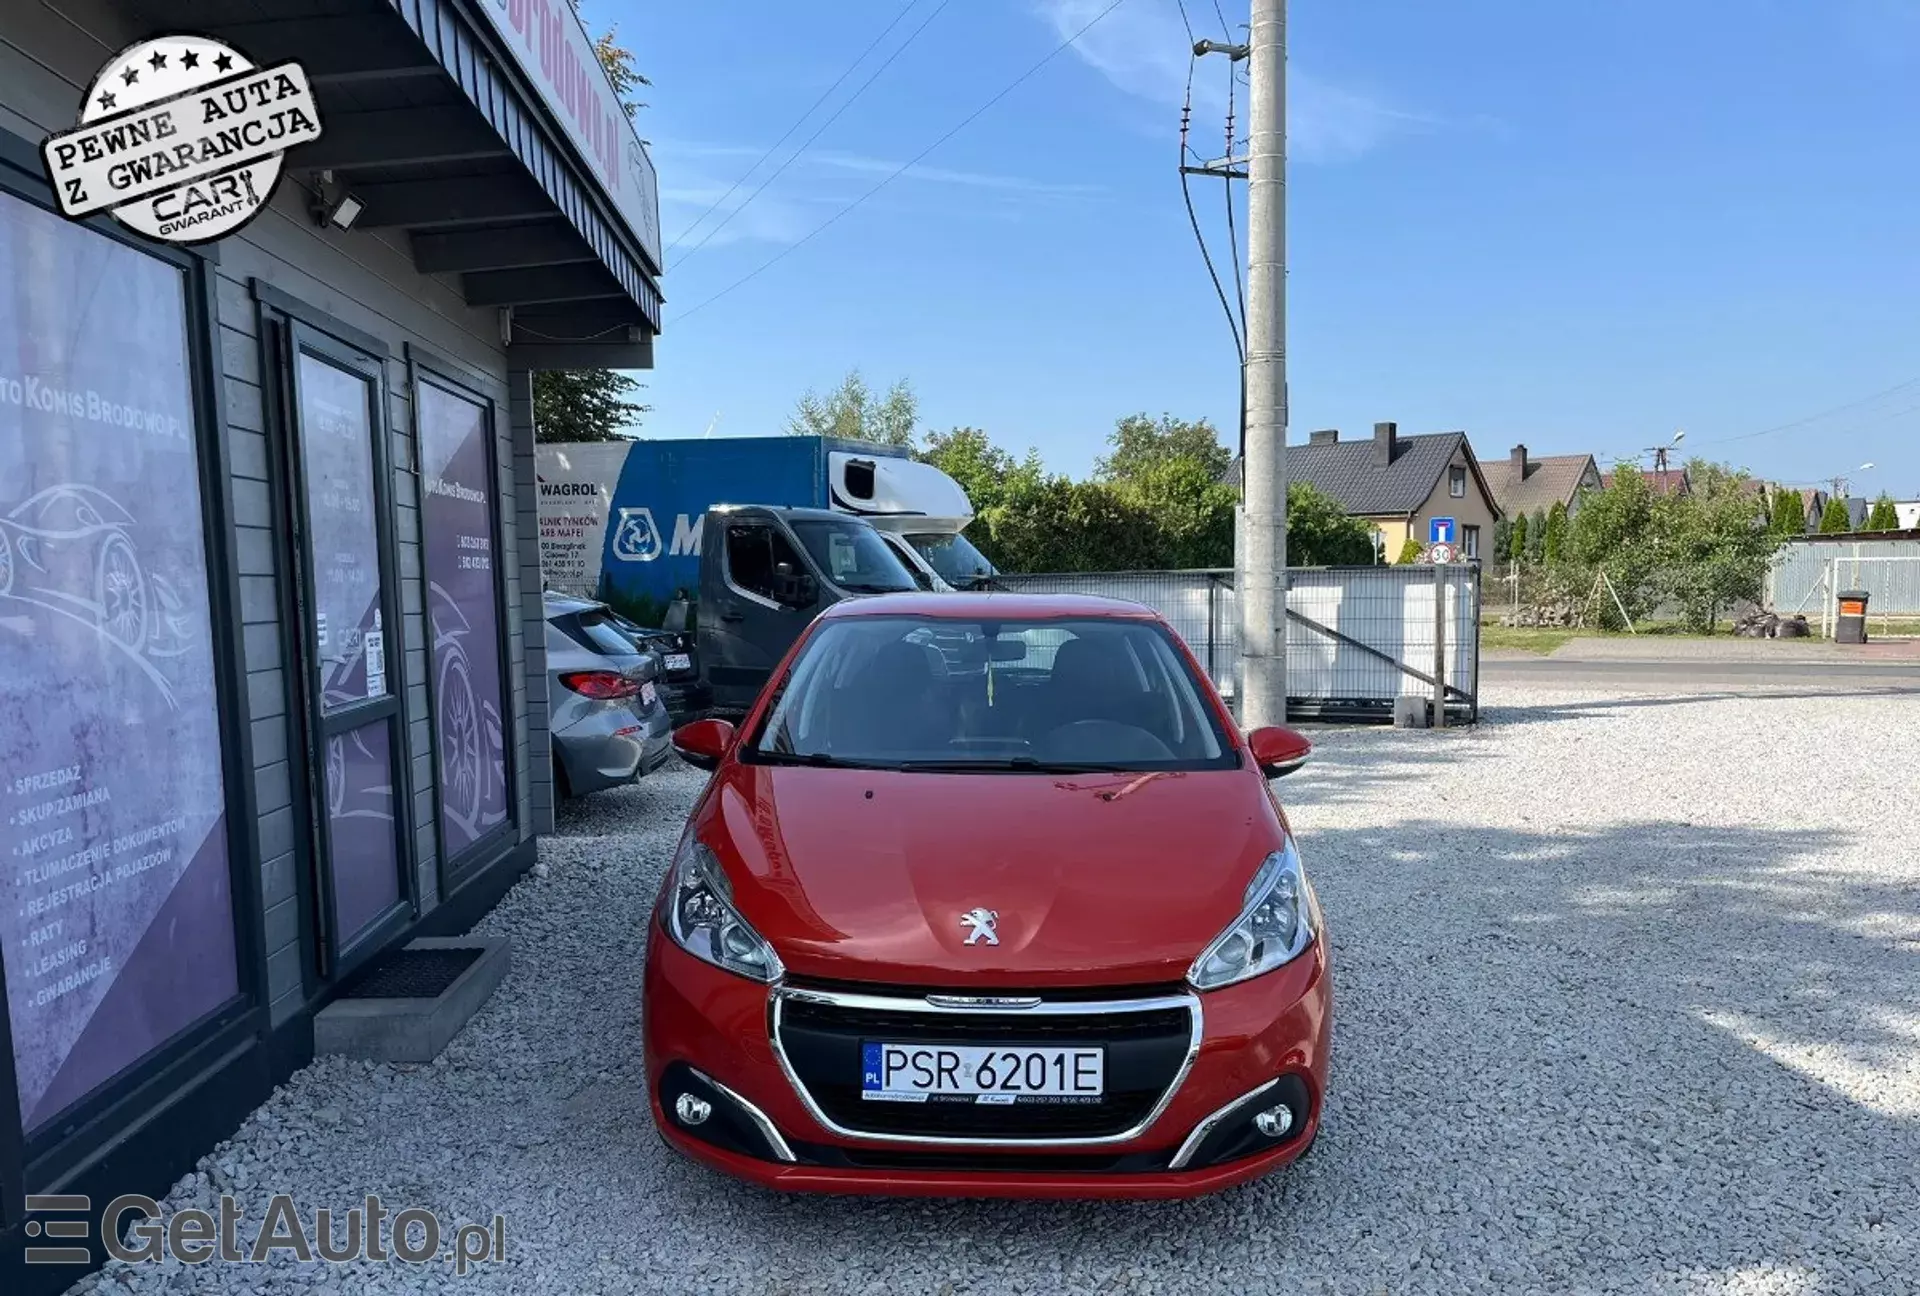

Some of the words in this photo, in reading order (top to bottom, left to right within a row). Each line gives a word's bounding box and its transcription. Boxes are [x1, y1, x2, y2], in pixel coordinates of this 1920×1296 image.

[540, 483, 598, 496] WAGROL
[22, 827, 74, 857] AKCYZA
[27, 870, 113, 917] REJESTRACJA
[30, 919, 64, 947] RATY
[33, 939, 88, 977] LEASING
[36, 956, 112, 1006] GWARANCJE
[865, 1074, 880, 1084] PL
[885, 1050, 960, 1089] PSR
[975, 1052, 1098, 1092] 6201E
